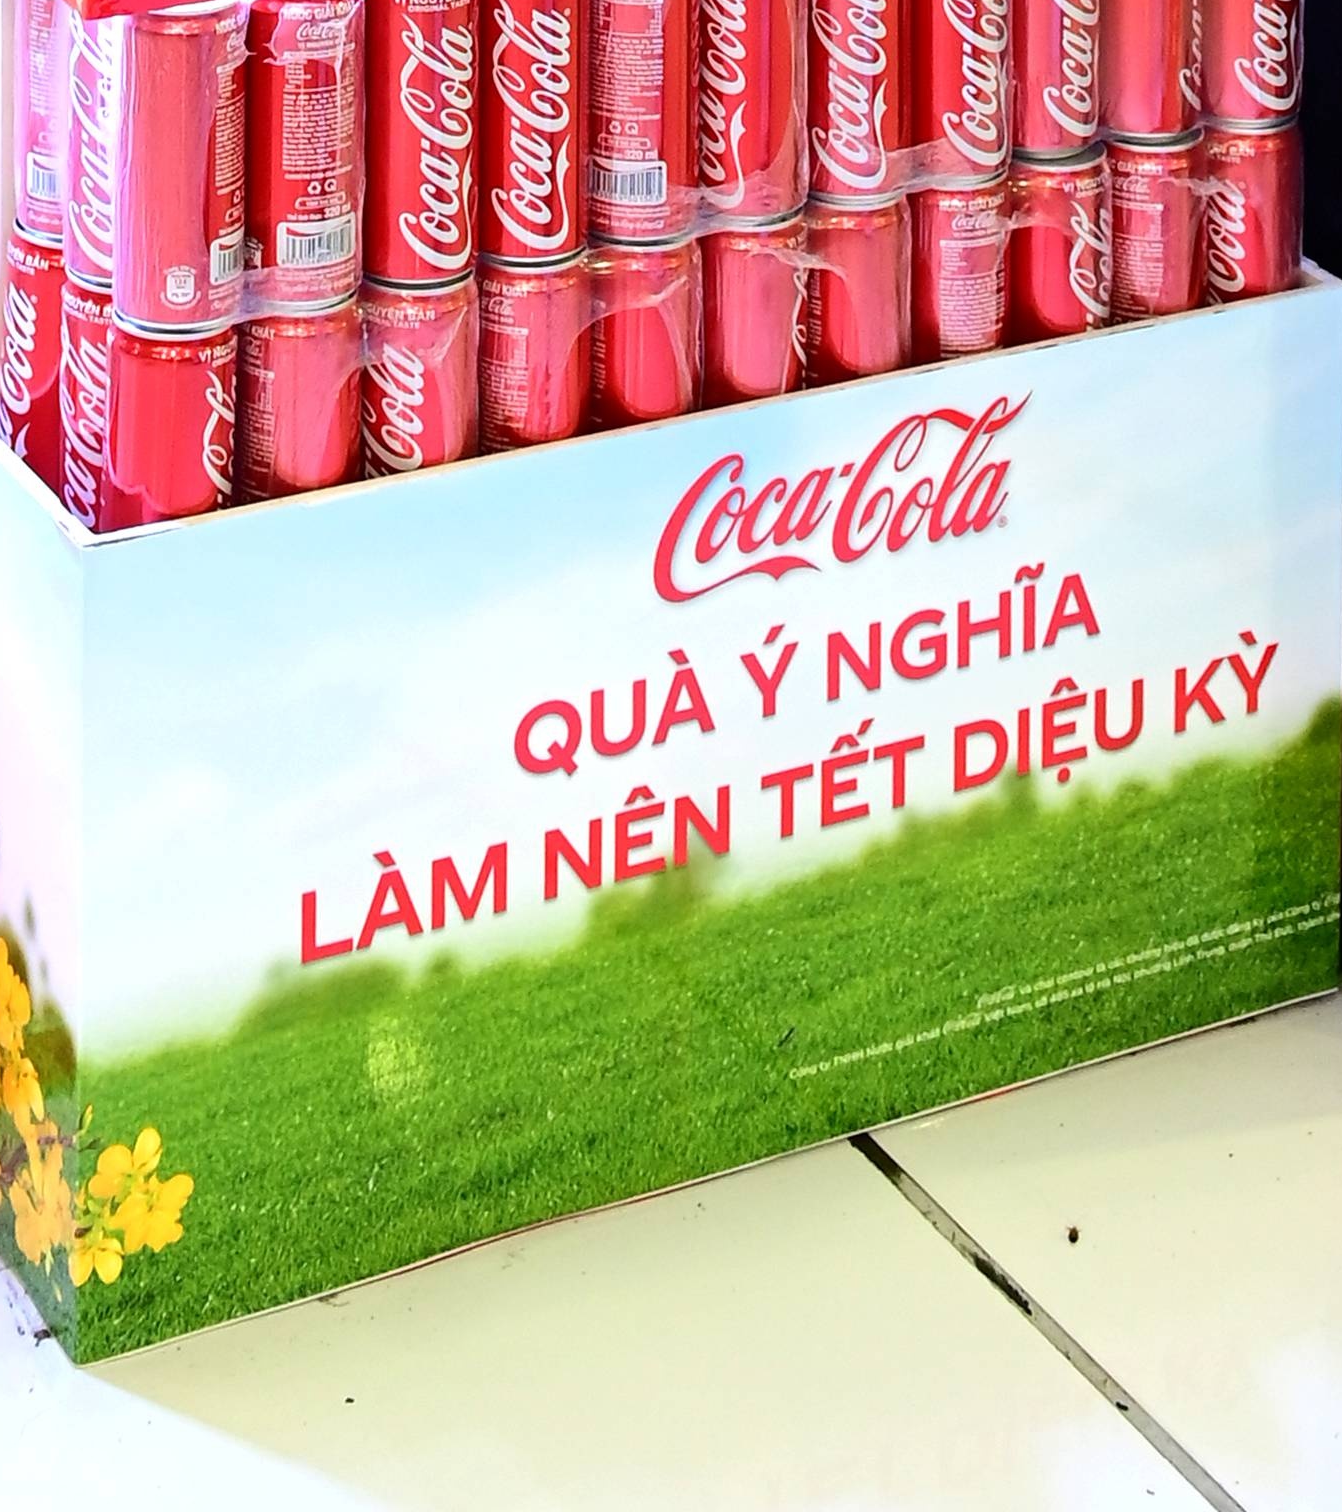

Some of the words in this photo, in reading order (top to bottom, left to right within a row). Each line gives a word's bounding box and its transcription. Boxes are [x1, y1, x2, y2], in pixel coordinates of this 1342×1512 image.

[398, 13, 474, 271] Coca-Cola
[651, 388, 1035, 604] Coca-Cola
[512, 647, 716, 779] QUÀ
[738, 625, 803, 720] Ý
[824, 562, 1101, 705] NGHĨA
[298, 842, 510, 968] LÀM
[542, 784, 733, 904] NÊN
[759, 719, 928, 843] TẾT
[951, 670, 1147, 793] DIỆU
[1170, 630, 1281, 736] KỲ
